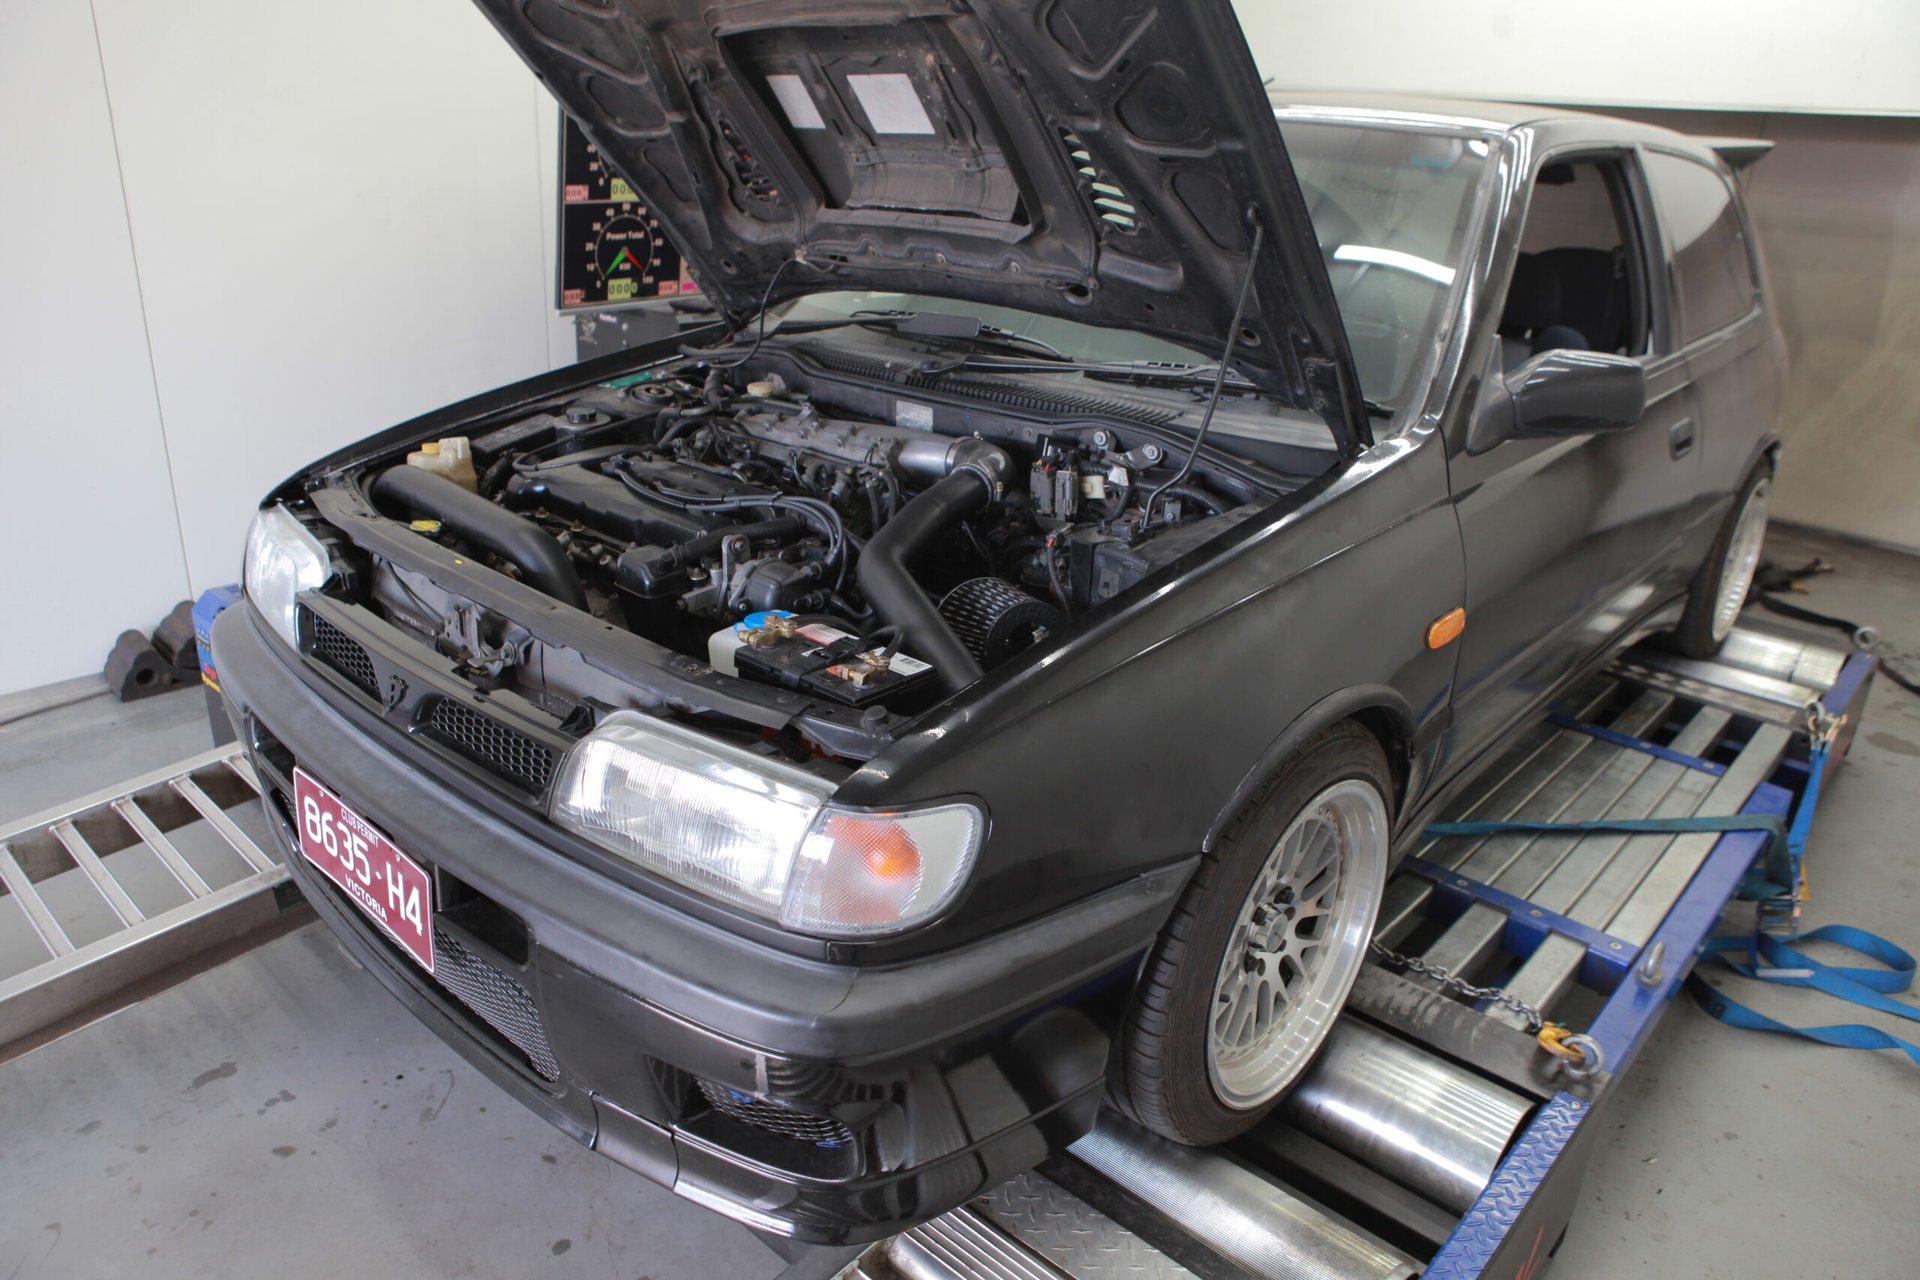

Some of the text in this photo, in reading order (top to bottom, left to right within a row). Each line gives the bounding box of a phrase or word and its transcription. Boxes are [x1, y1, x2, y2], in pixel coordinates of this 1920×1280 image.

[606, 230, 645, 240] Power Total
[345, 874, 388, 922] VICTORIA
